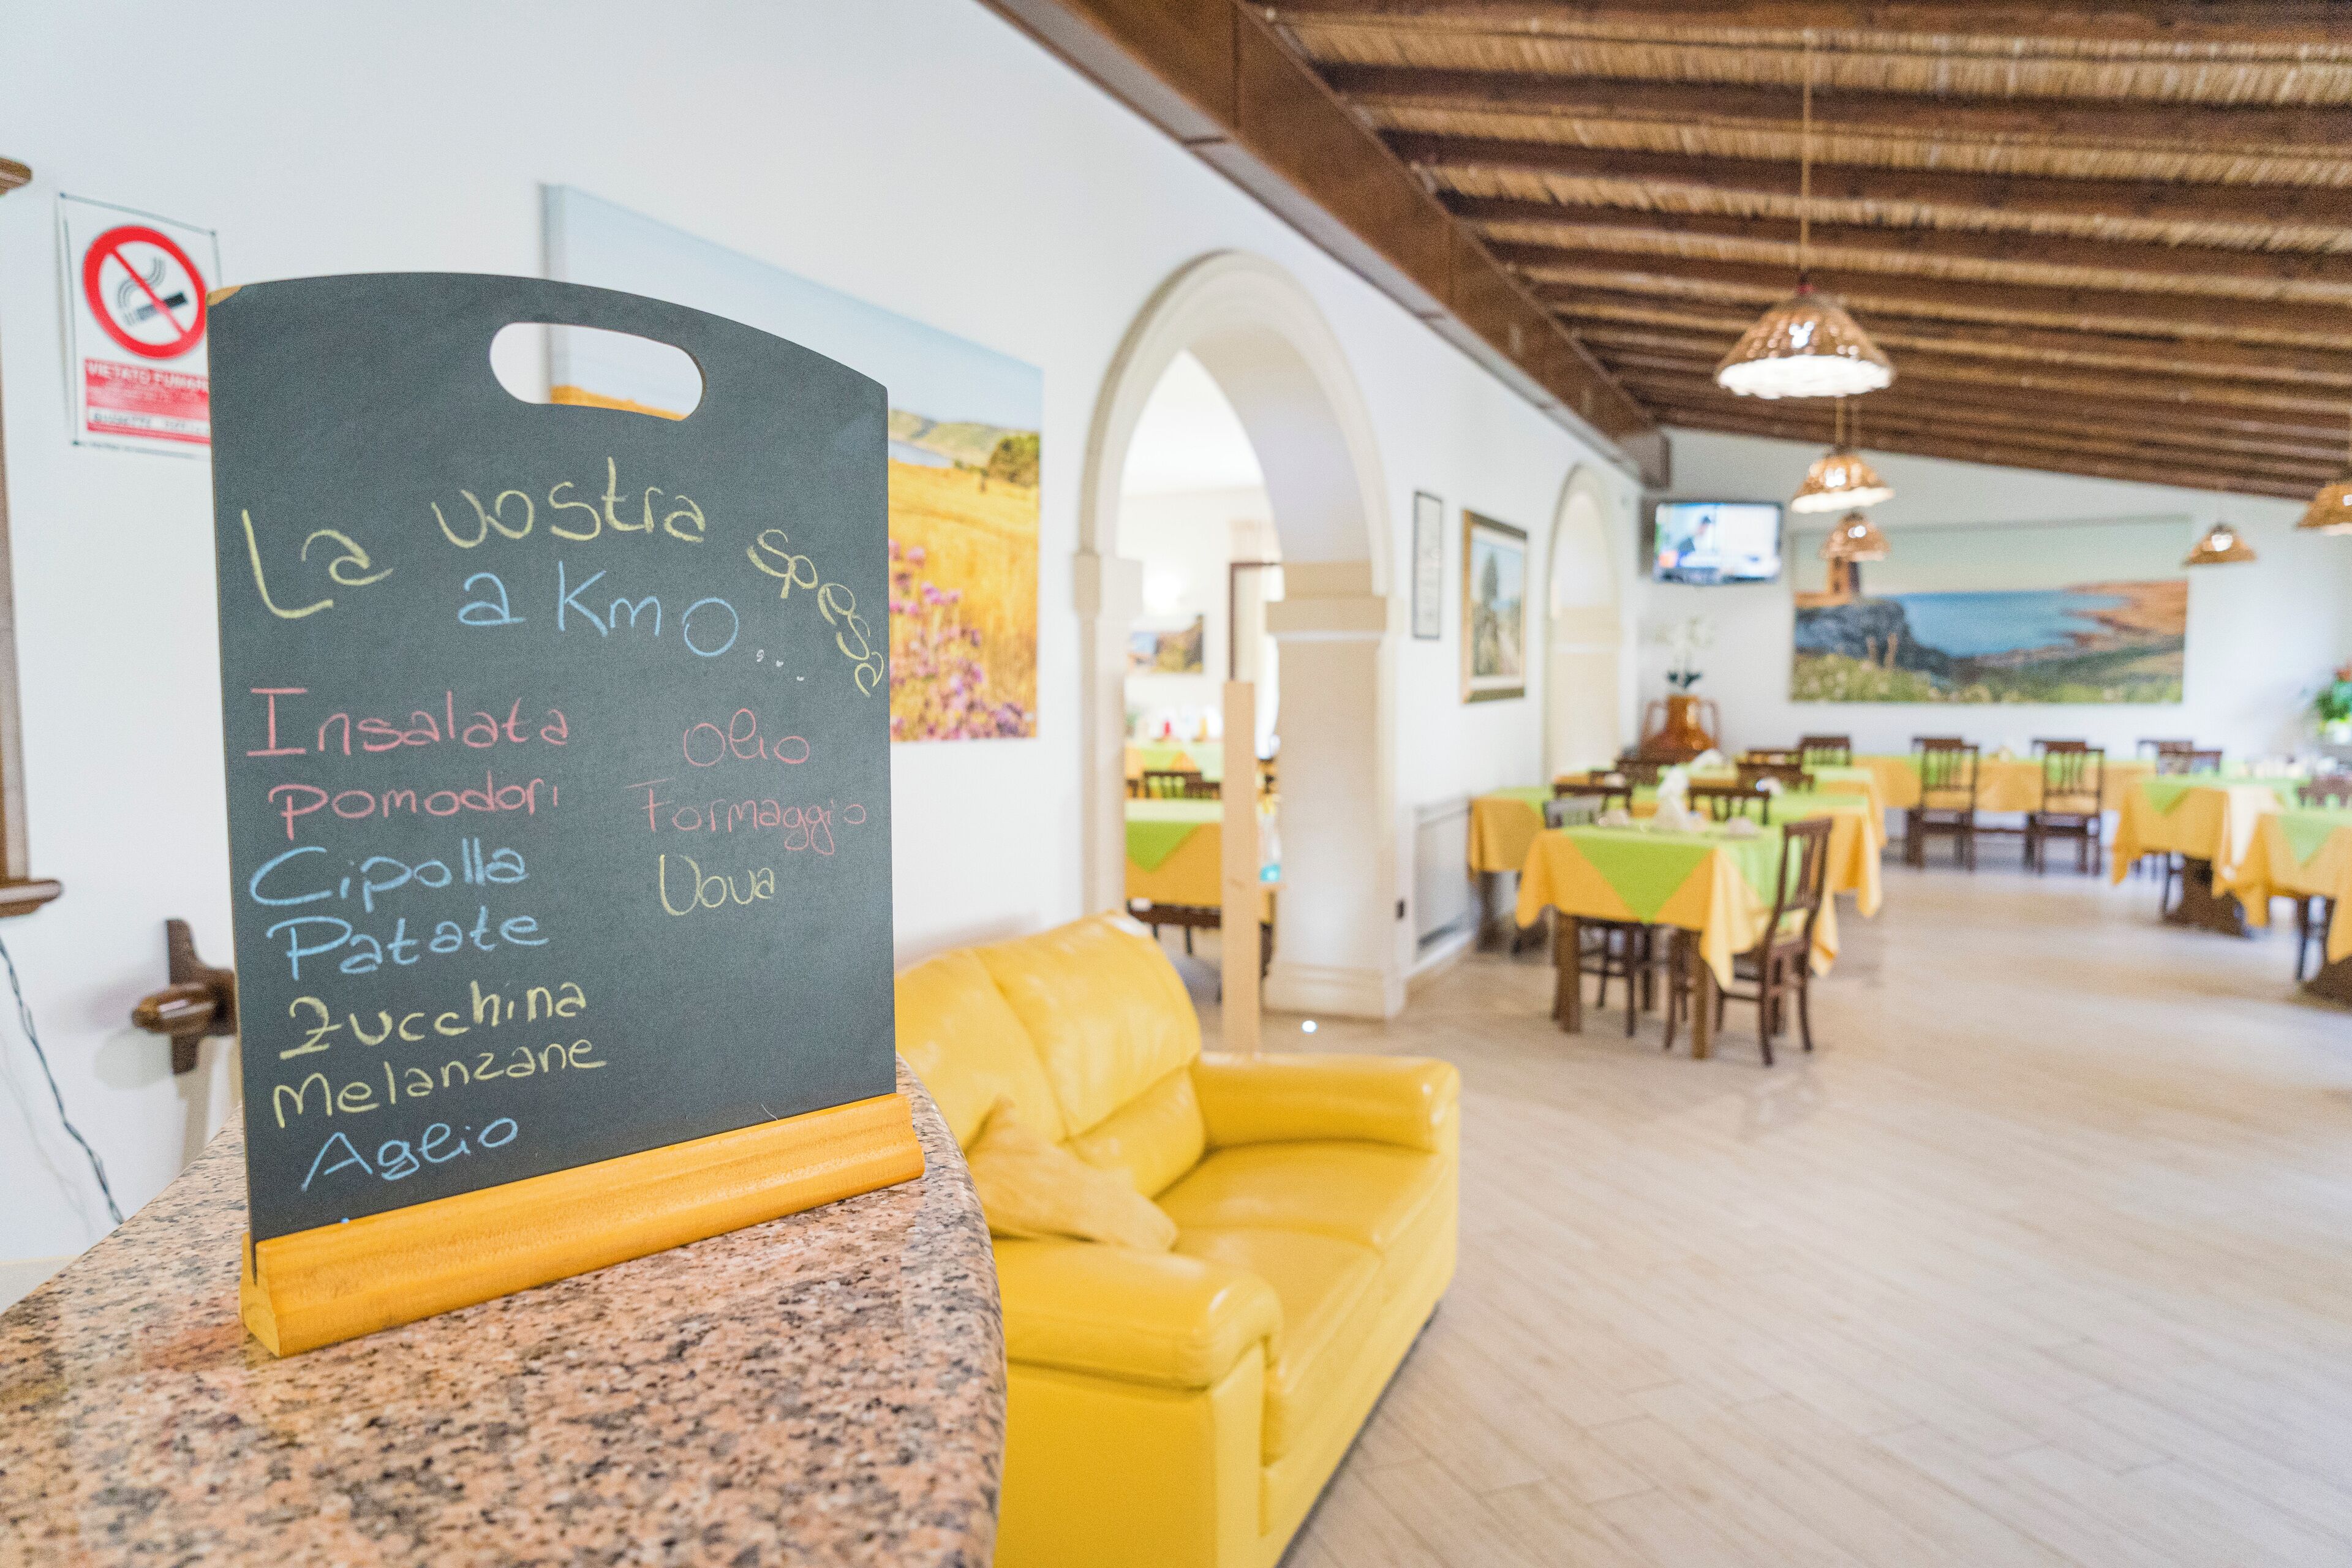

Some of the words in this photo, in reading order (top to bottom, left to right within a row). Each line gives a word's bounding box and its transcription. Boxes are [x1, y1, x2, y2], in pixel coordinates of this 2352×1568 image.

[242, 509, 394, 619] La
[430, 456, 706, 549] vostra
[746, 528, 885, 698] spesa
[456, 572, 527, 626] a
[246, 688, 570, 757] Insalata
[683, 707, 810, 767] Olio
[268, 769, 559, 841] Pomodori
[624, 777, 867, 856] Formaggio
[249, 837, 529, 913] Cipolla
[658, 853, 775, 916] Uova
[266, 905, 550, 981] Patate
[279, 980, 587, 1060] Zucchina
[272, 1038, 608, 1129] Melanzane
[300, 1117, 519, 1191] Aglio
